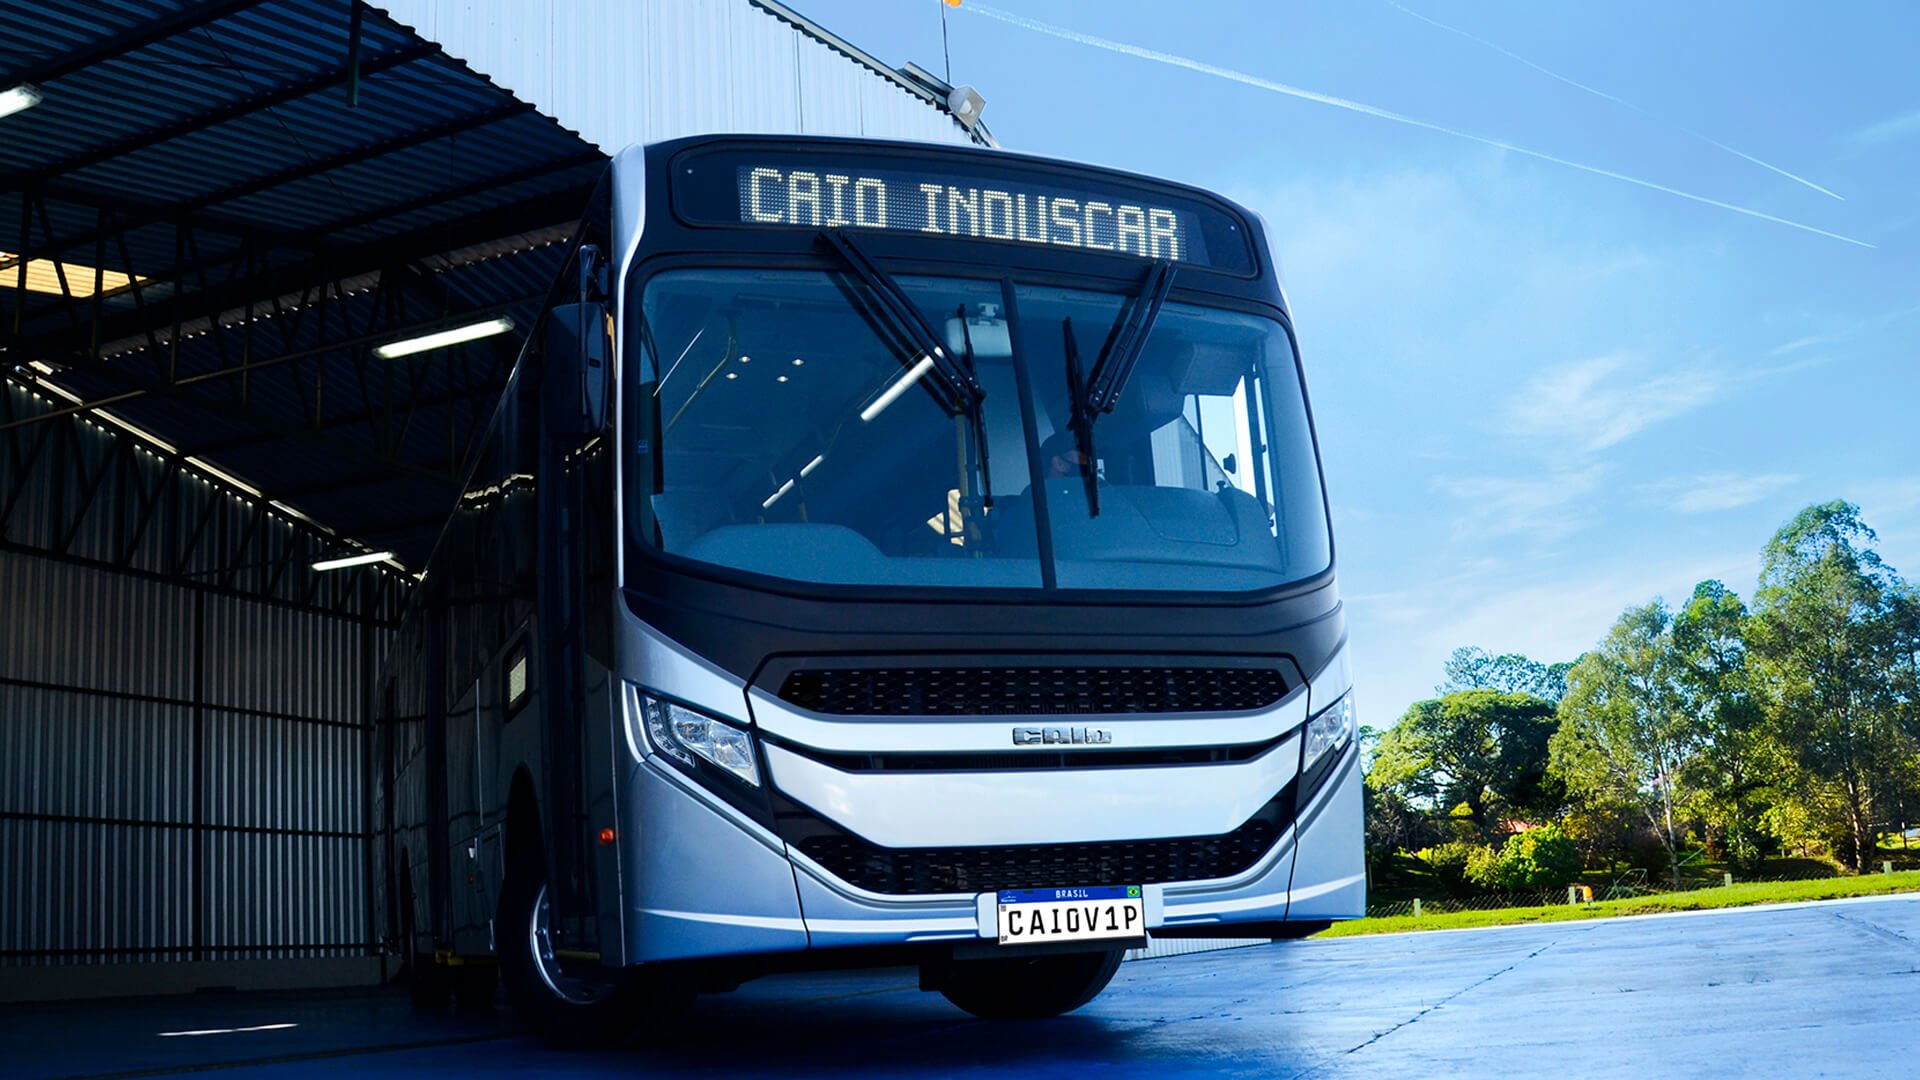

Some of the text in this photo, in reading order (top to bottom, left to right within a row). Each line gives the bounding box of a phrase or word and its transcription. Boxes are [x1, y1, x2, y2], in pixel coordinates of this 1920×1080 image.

[750, 167, 1179, 260] CAIO INDUSCAR
[1012, 727, 1112, 746] CAIO
[1055, 888, 1089, 899] BRASIL
